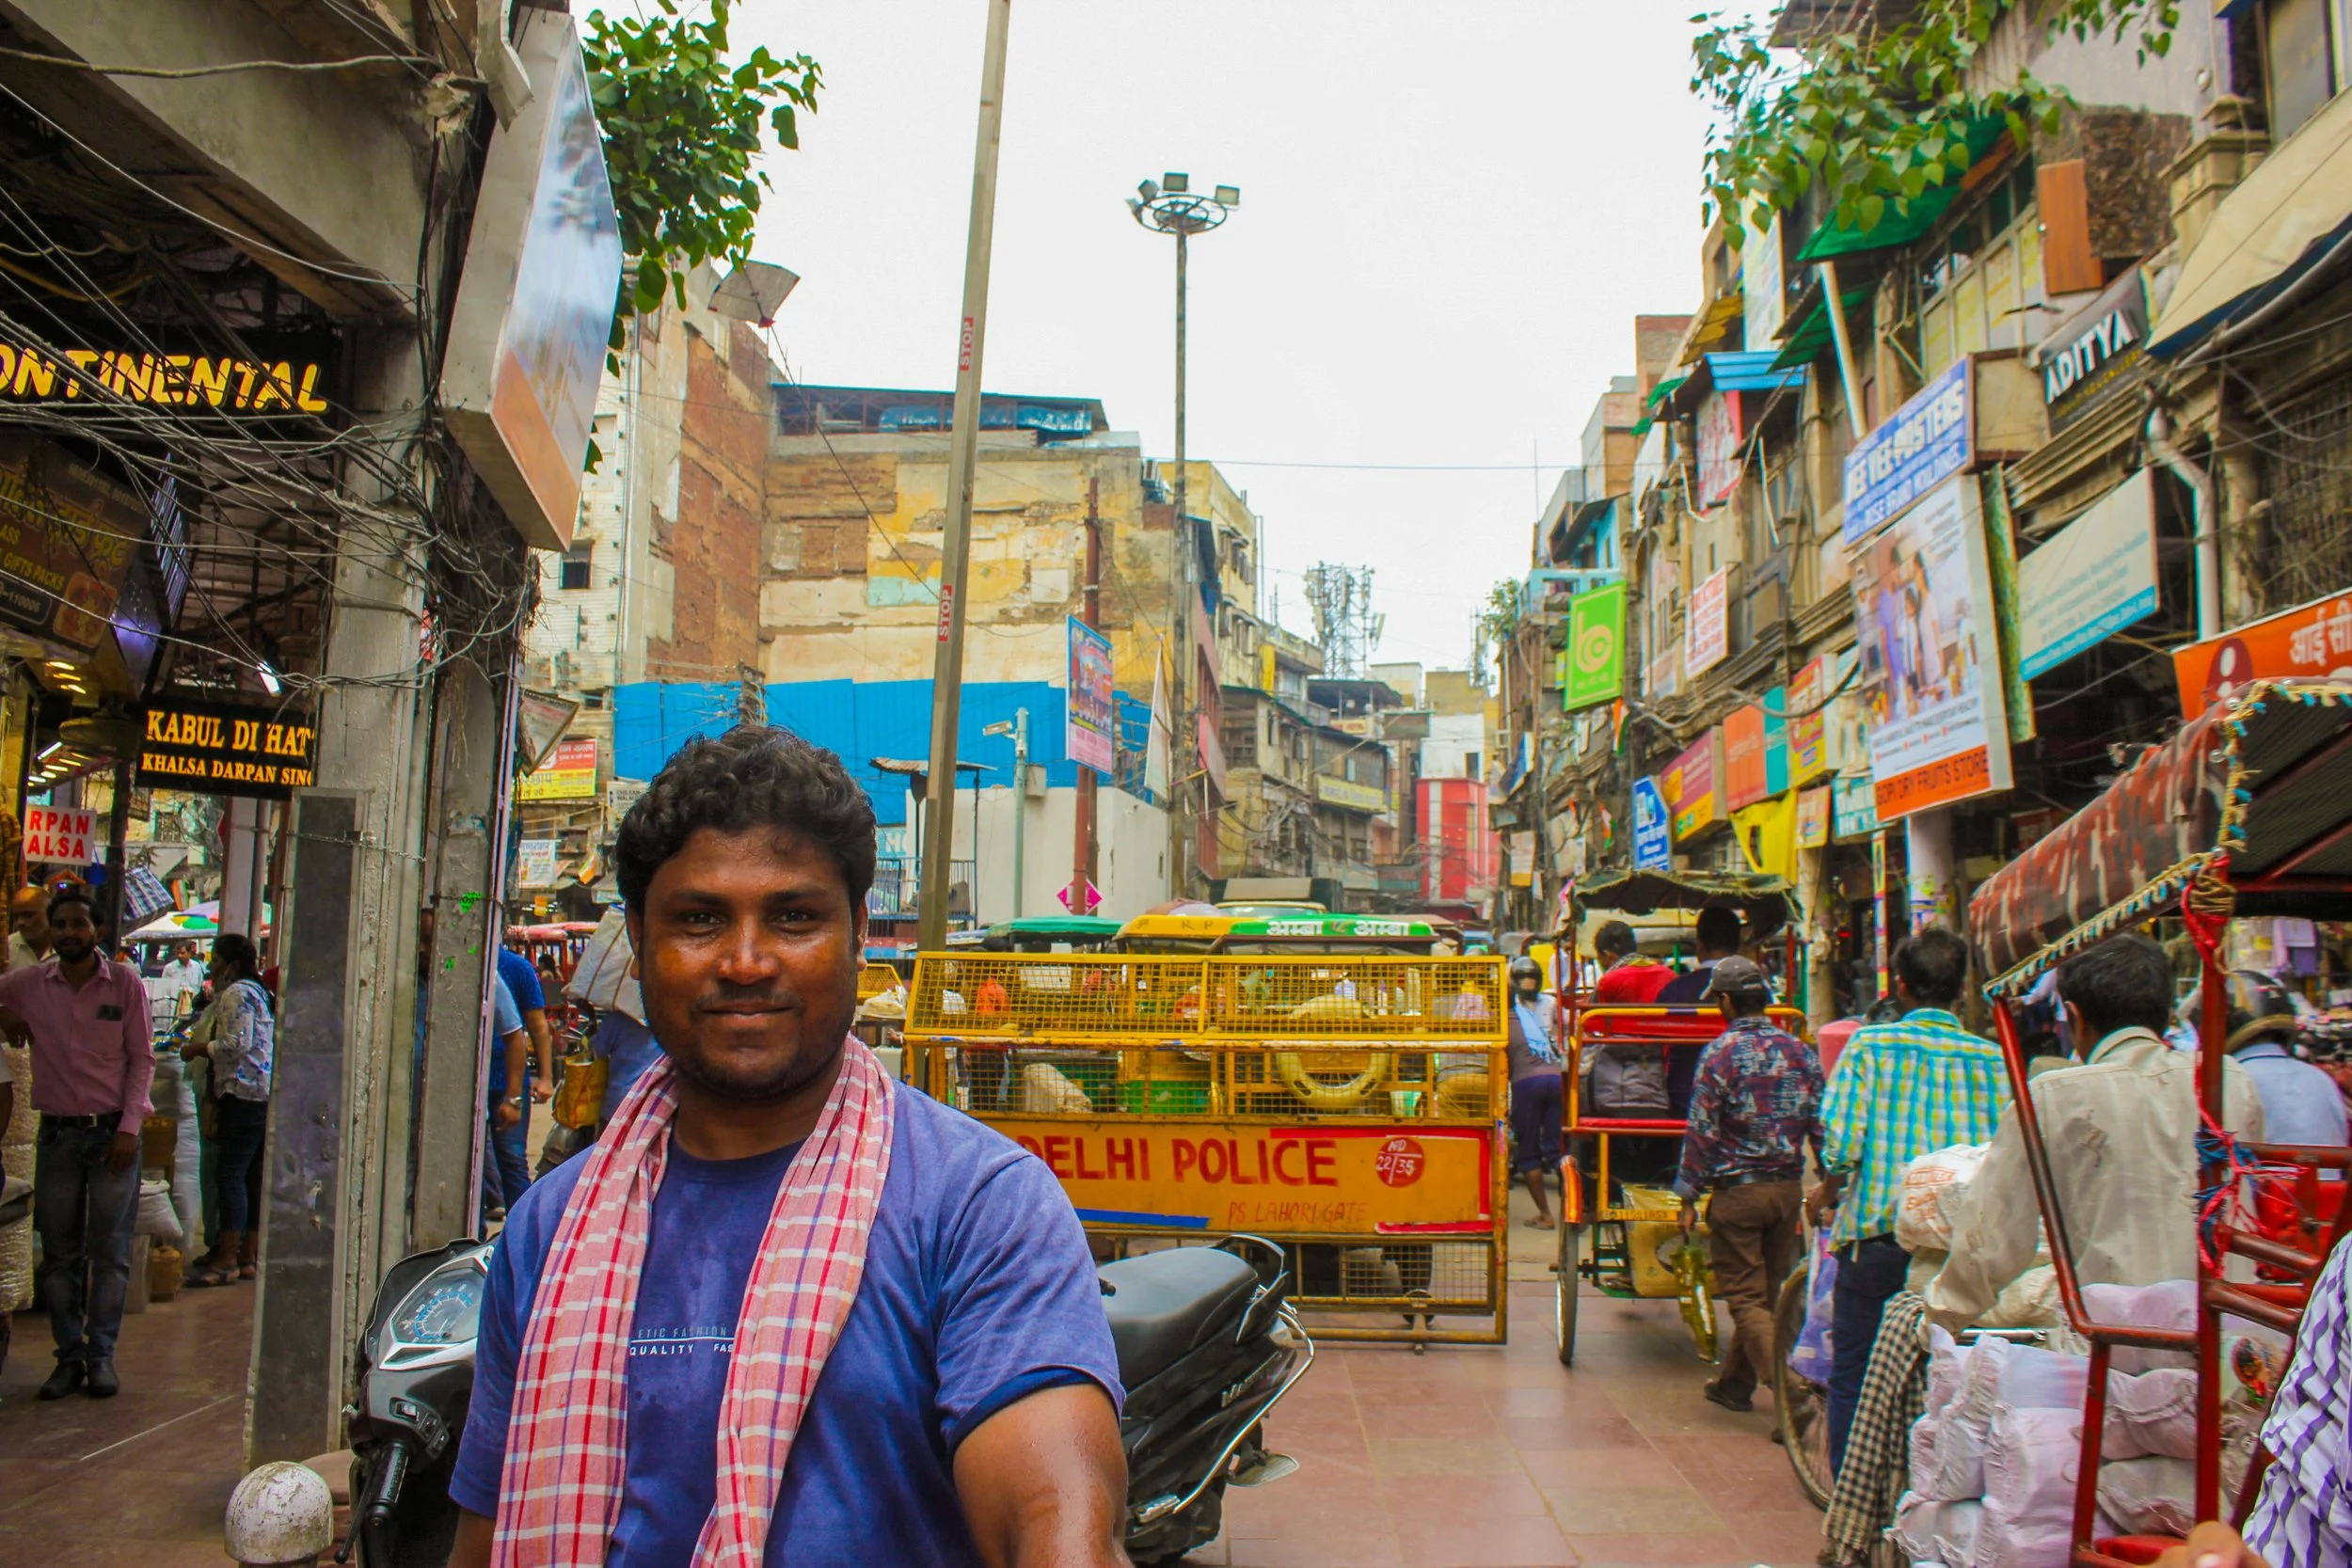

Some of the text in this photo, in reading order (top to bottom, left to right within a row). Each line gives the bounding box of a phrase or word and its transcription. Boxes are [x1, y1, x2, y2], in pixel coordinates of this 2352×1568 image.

[961, 318, 974, 368] STOP
[2045, 309, 2134, 404] ADITYA
[4, 552, 65, 592] GIFTS PACKS
[939, 587, 952, 641] STOP
[146, 710, 225, 749] KABUL
[231, 720, 260, 752] DI
[141, 752, 207, 777] KHALSA
[212, 760, 277, 784] DARPAN
[29, 810, 90, 836] RPAN
[27, 834, 85, 859] ALSA
[1266, 921, 1409, 936] अम्बा अम्बा
[1170, 1137, 1340, 1187] POLICE
[1228, 1201, 1368, 1224] PS LAHORI GATE
[674, 1324, 727, 1338] FASHION
[629, 1343, 694, 1356] QUALITY
